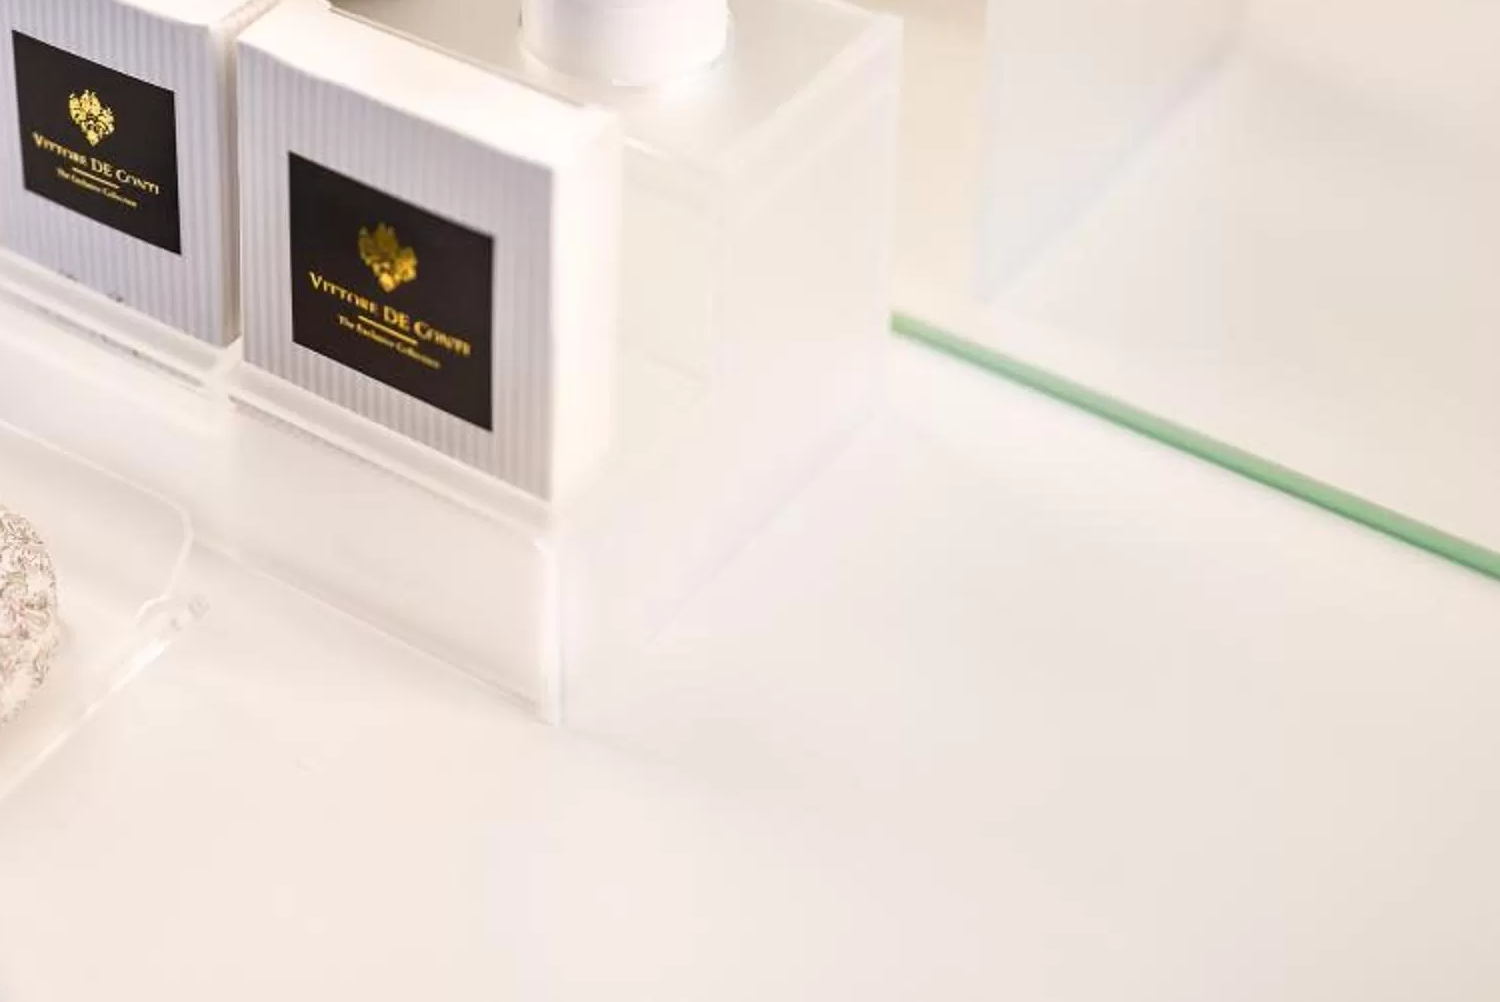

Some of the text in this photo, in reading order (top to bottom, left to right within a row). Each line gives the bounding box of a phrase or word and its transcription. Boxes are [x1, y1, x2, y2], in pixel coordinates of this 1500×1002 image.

[31, 130, 161, 195] VITTORE DE CONTI
[308, 270, 472, 358] VITTORE DE CONTI
